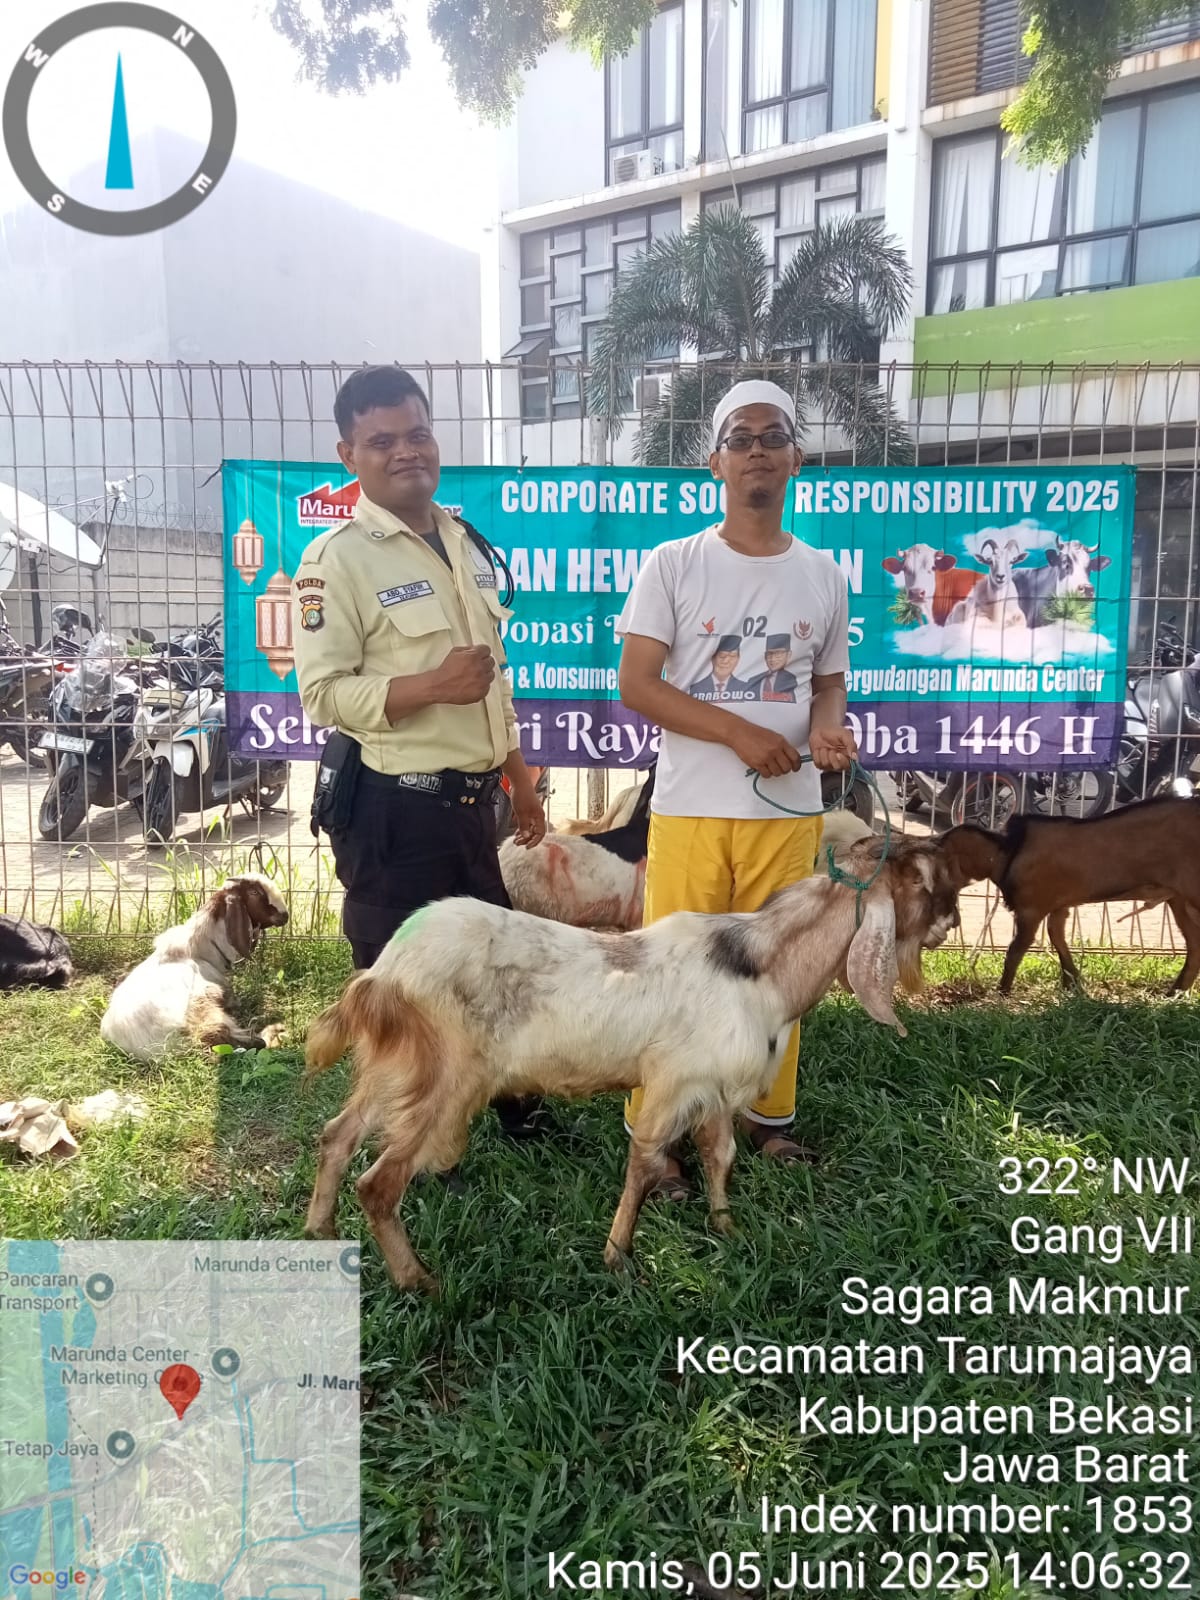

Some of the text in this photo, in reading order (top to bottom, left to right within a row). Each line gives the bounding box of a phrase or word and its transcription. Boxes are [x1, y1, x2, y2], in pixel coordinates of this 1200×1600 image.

[500, 480, 669, 515] CORPORATE
[794, 479, 1038, 514] RESPONSIBILITY
[1045, 479, 1120, 513] 2025
[742, 615, 768, 638] 02
[517, 665, 531, 689] &
[955, 664, 1038, 693] Marunda
[1041, 664, 1105, 693] Center
[934, 714, 1042, 757] 1446
[1058, 715, 1100, 756] H
